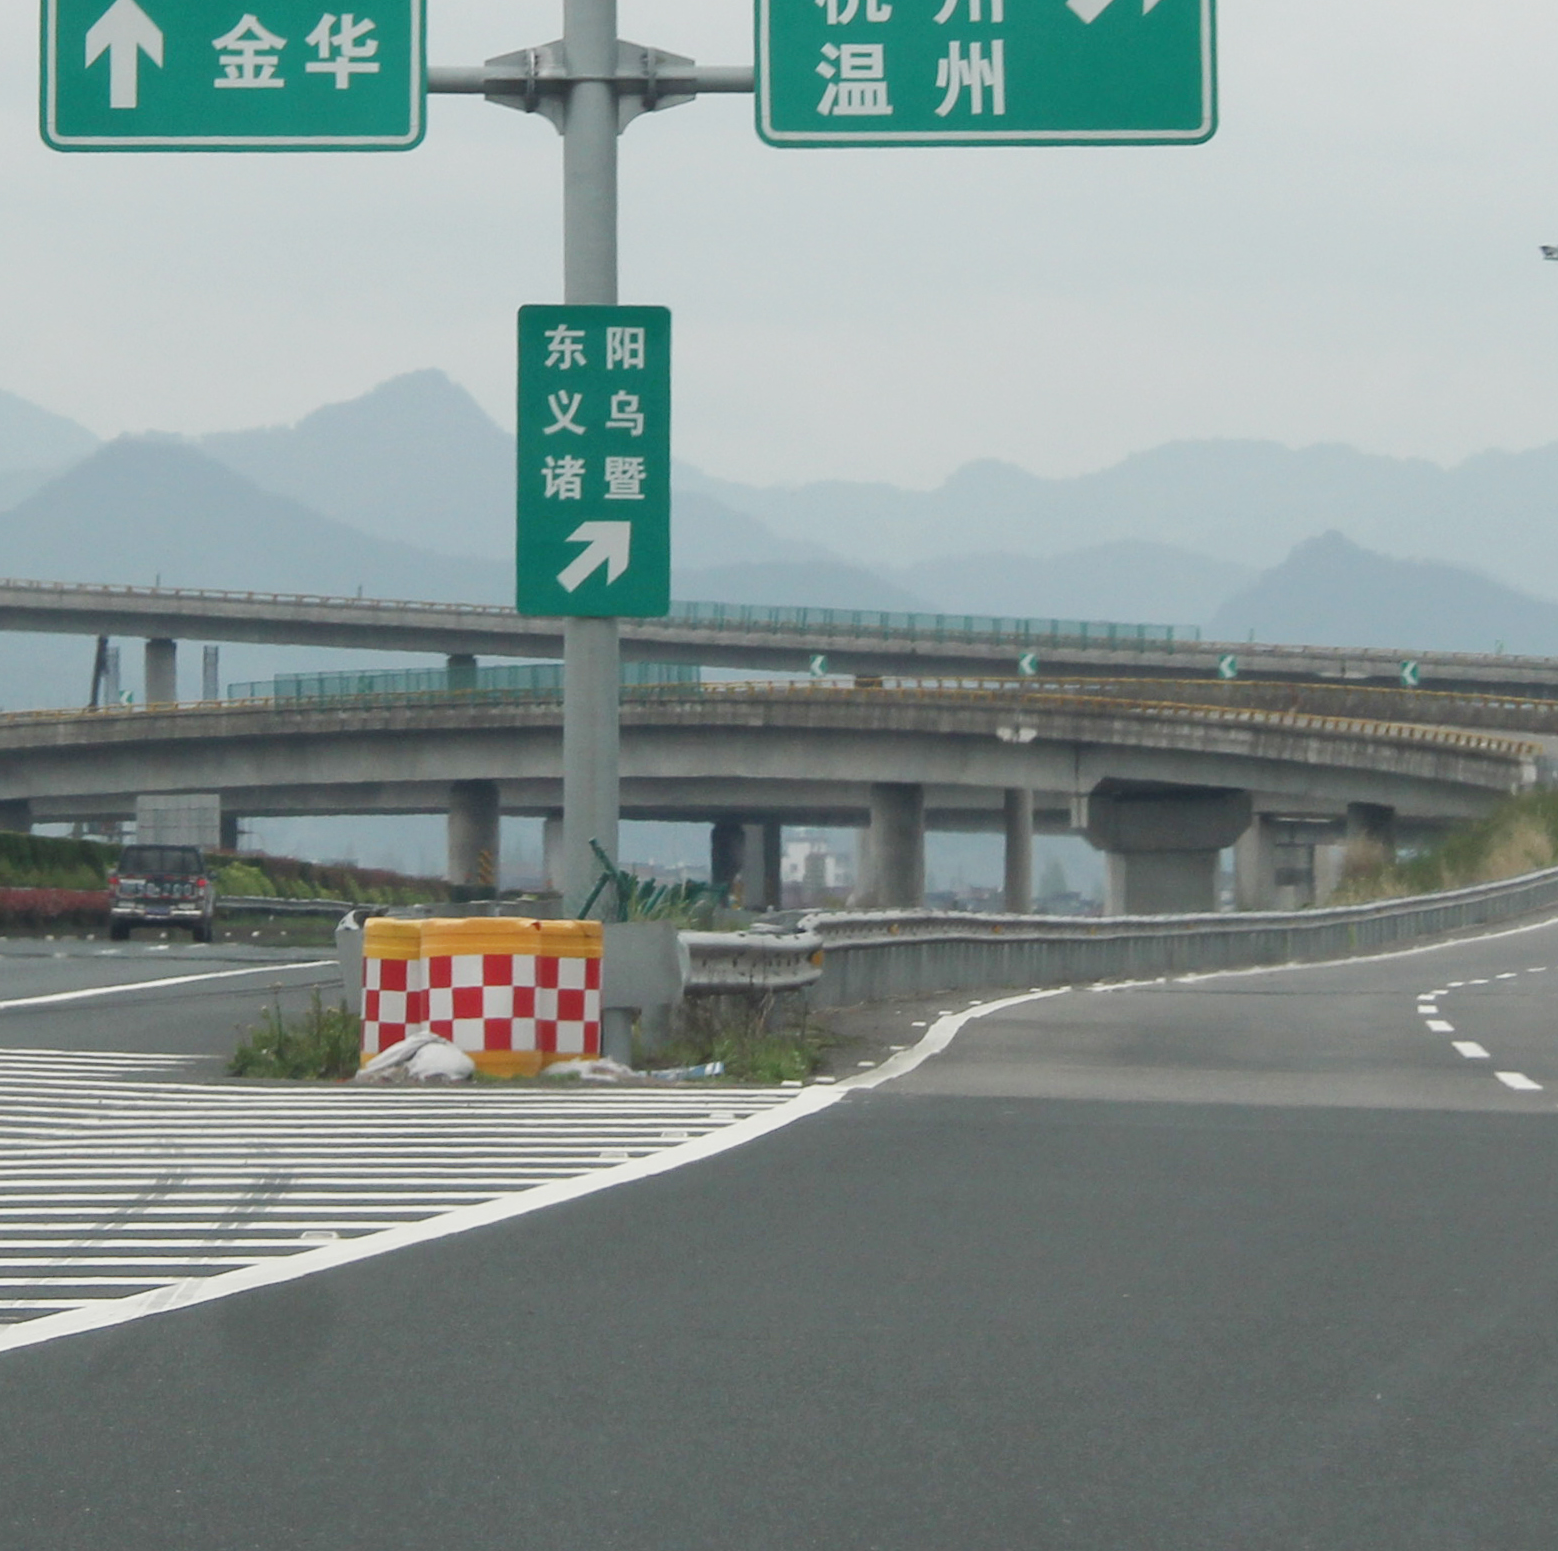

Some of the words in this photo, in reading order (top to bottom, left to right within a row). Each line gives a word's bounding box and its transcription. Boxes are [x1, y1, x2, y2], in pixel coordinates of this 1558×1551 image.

[211, 13, 381, 90] 金华
[815, 38, 1006, 117] 温州
[543, 323, 646, 370] 东阳
[543, 389, 646, 437] 义乌
[541, 454, 647, 500] 诸暨
